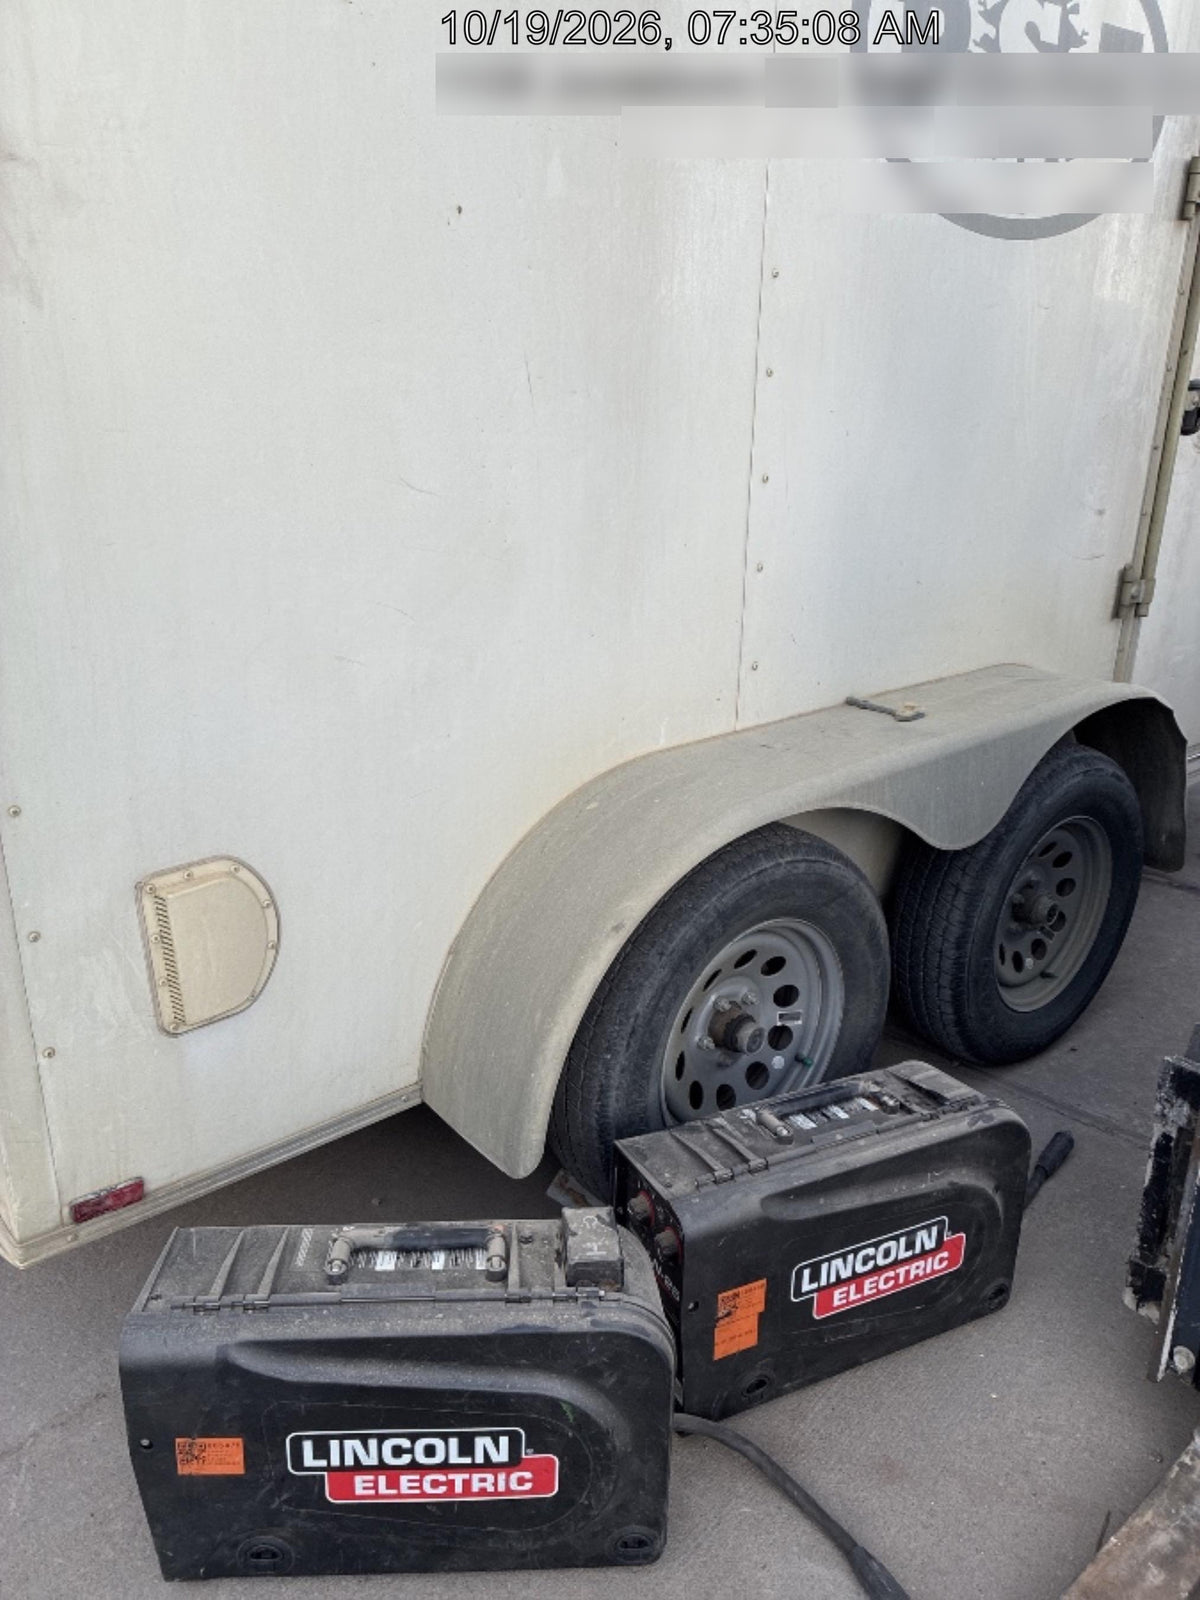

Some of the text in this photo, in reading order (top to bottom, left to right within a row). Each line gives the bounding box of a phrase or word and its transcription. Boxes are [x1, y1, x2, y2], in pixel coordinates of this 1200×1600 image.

[801, 1225, 939, 1293] LINCOLN
[831, 1251, 950, 1308] ELECTRIC
[302, 1435, 510, 1468] LINCOLN
[353, 1471, 534, 1497] ELECTRIC
